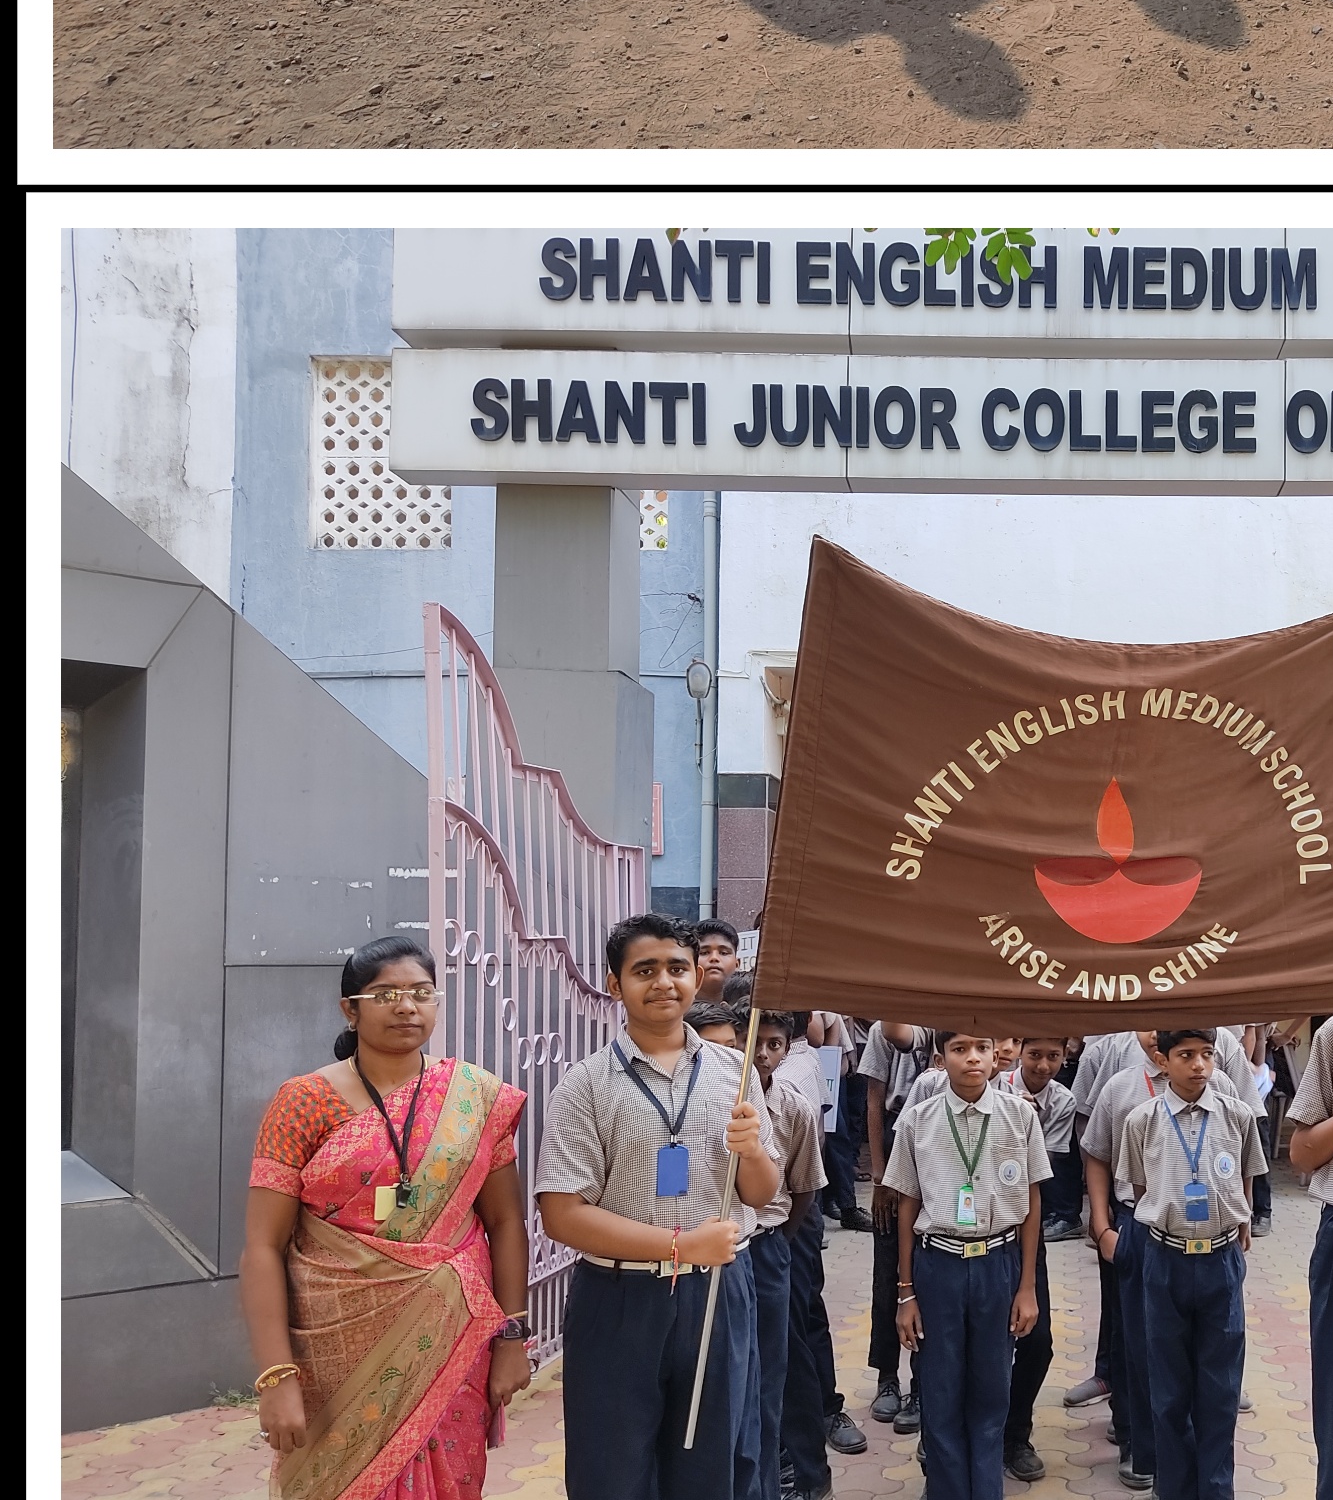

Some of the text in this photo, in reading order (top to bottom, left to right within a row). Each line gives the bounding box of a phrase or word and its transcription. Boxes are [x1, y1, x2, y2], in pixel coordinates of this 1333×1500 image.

[538, 237, 771, 304] SHANTI
[796, 241, 1057, 308] ENGLISH
[1083, 245, 1317, 311] MEDIUM
[470, 378, 707, 446] SHANTI
[733, 384, 960, 450] JUNIOR
[981, 387, 1257, 453] COLLEGE
[885, 688, 1332, 885] SHANTI ENGLISH MEDIUM SCHOOL
[979, 911, 1239, 1002] ARISE AND SHINE
